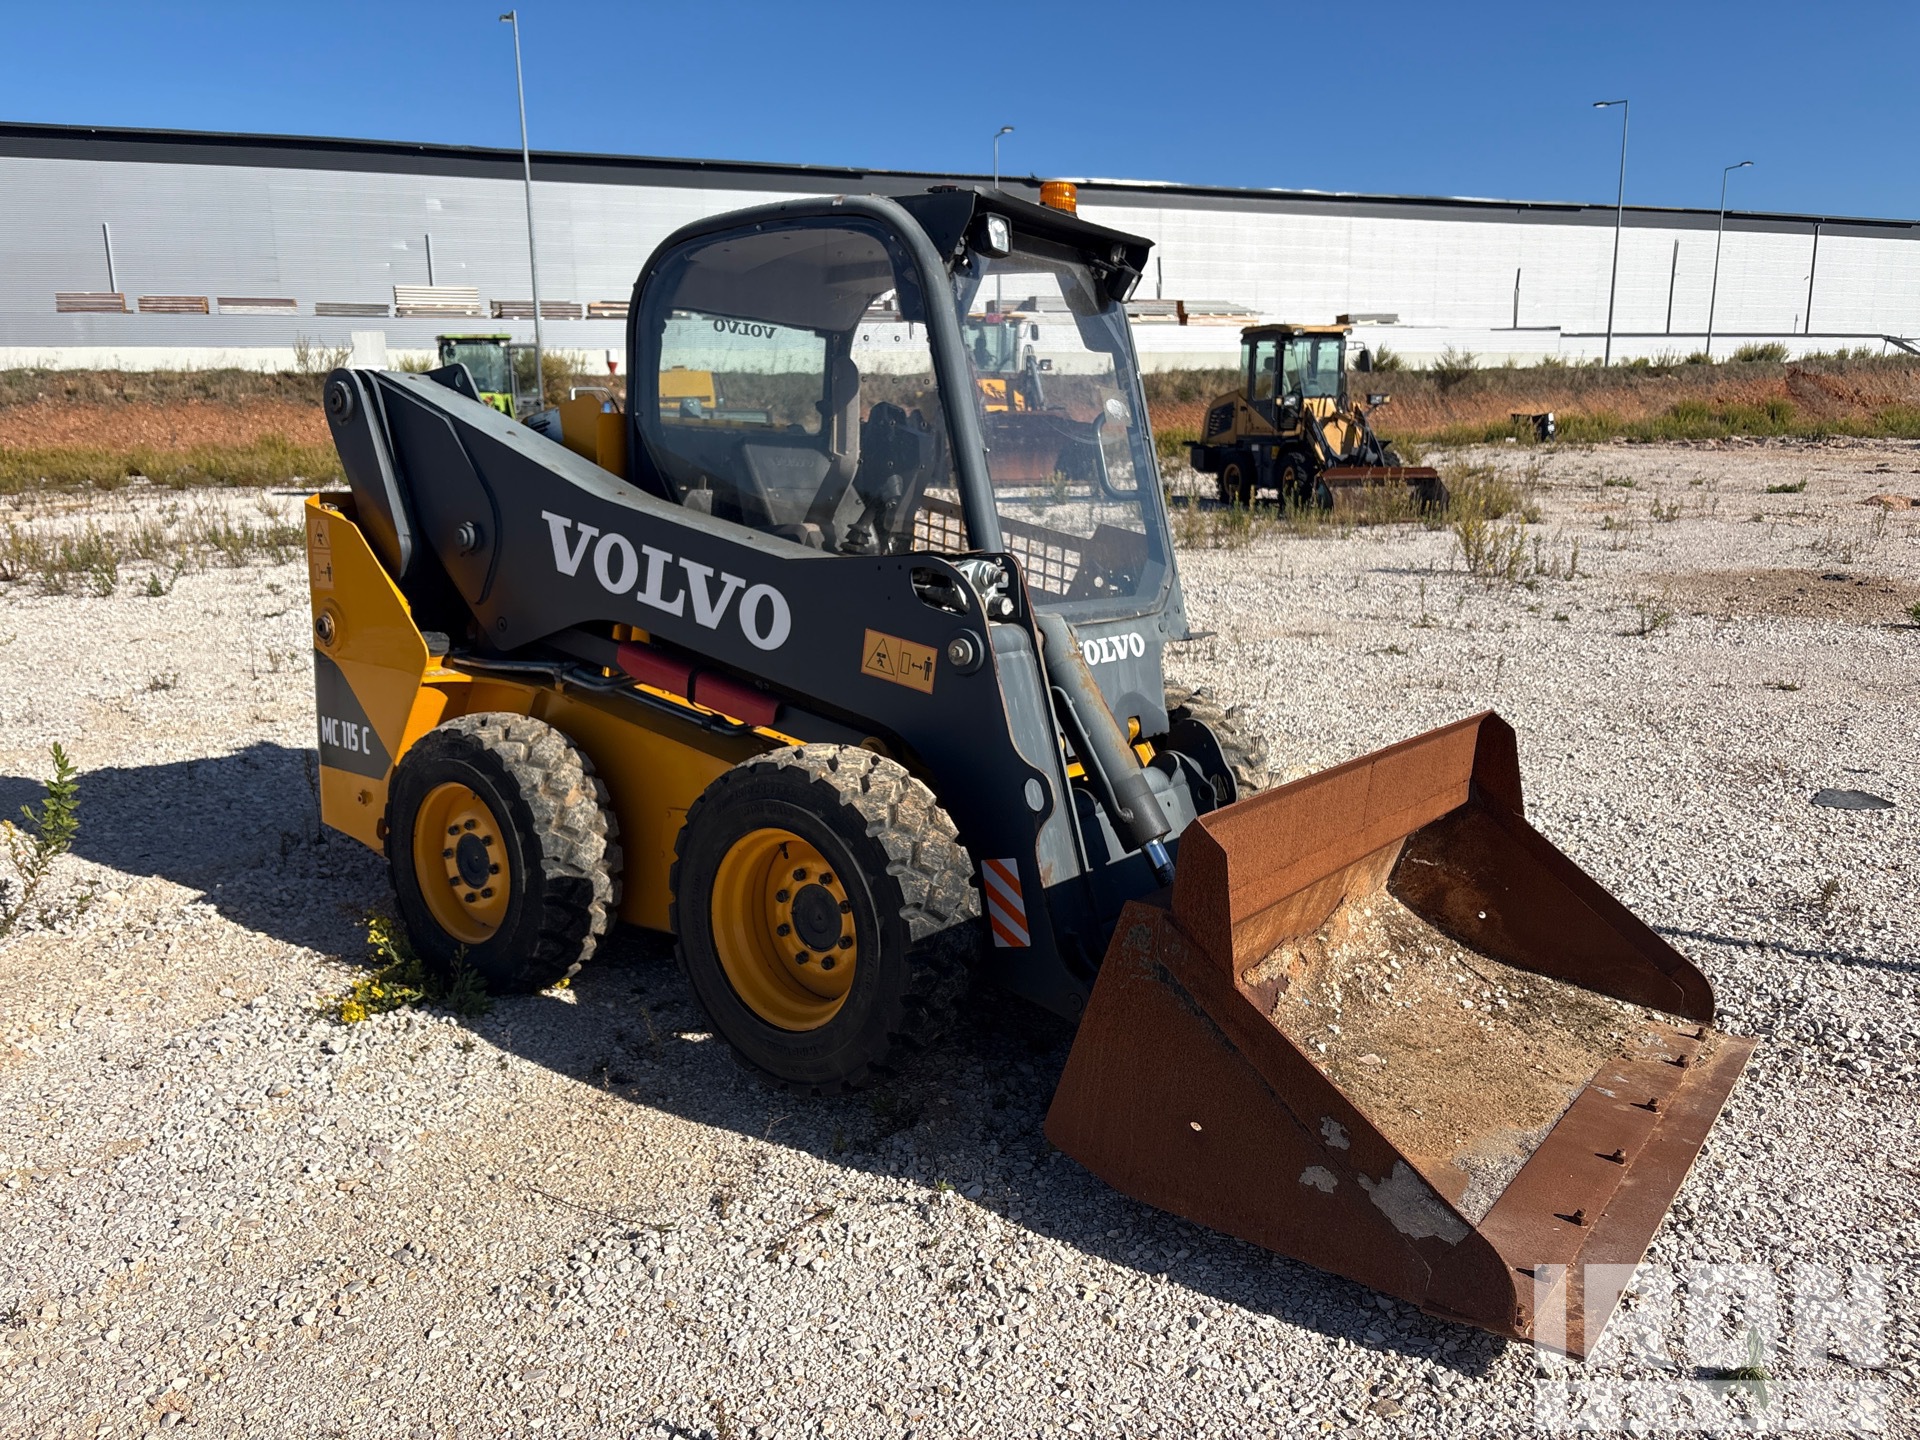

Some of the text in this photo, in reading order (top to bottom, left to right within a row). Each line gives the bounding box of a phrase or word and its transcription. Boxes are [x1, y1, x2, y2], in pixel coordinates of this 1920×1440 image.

[541, 510, 792, 650] VOLVO
[321, 715, 371, 755] MC 115 C
